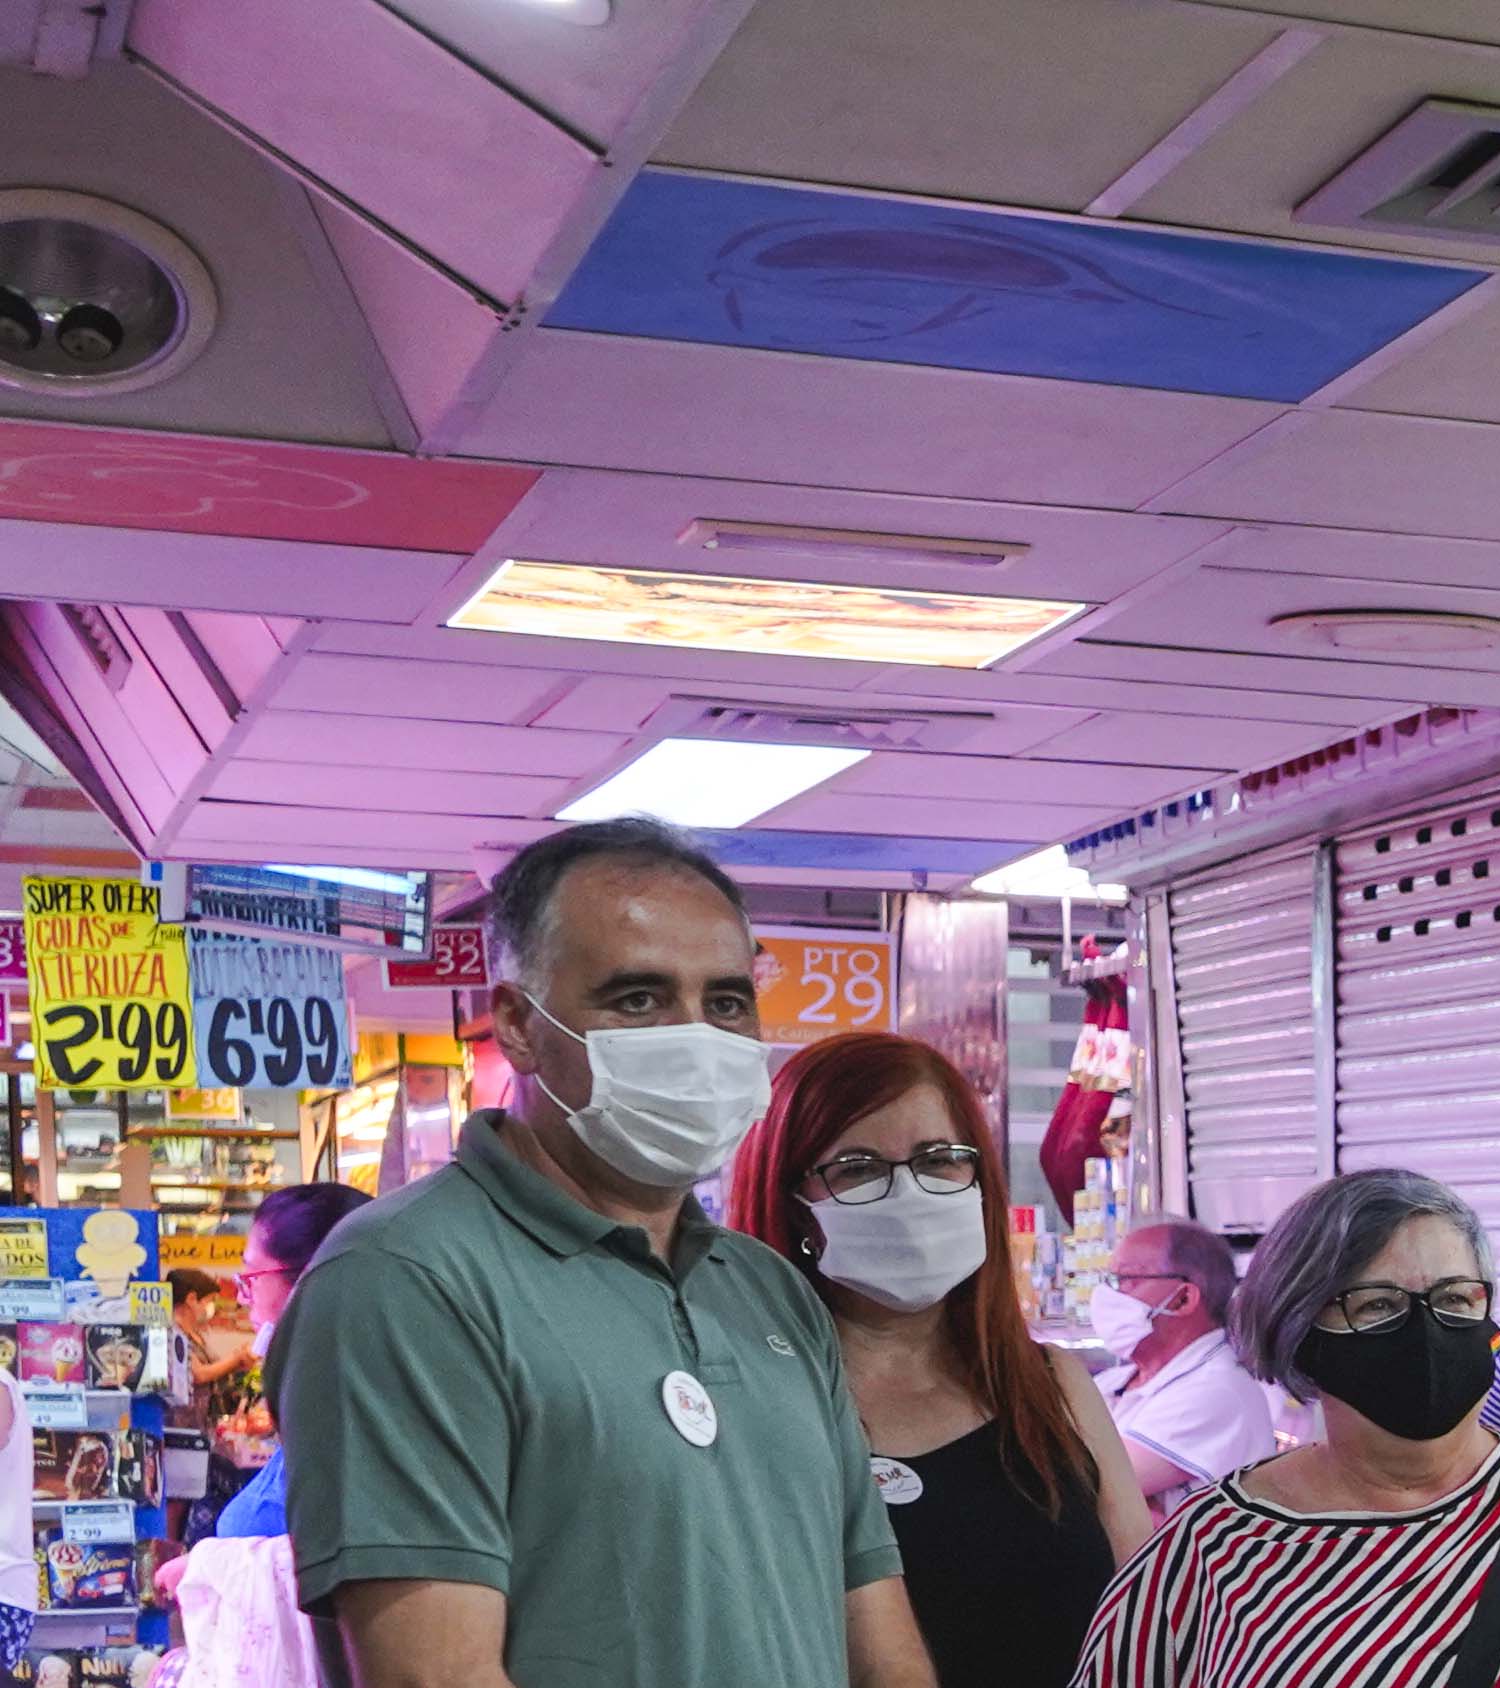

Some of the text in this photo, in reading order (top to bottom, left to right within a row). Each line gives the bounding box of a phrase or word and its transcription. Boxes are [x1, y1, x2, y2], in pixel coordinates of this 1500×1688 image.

[27, 884, 95, 914] SUPER
[103, 885, 161, 914] OFER
[36, 917, 111, 951] COLAS
[37, 952, 169, 999] MERLUZA
[435, 944, 481, 975] 32
[803, 946, 880, 977] PTO
[797, 973, 885, 1026] 29
[43, 1002, 188, 1085] 2'99
[207, 996, 339, 1087] 6'99
